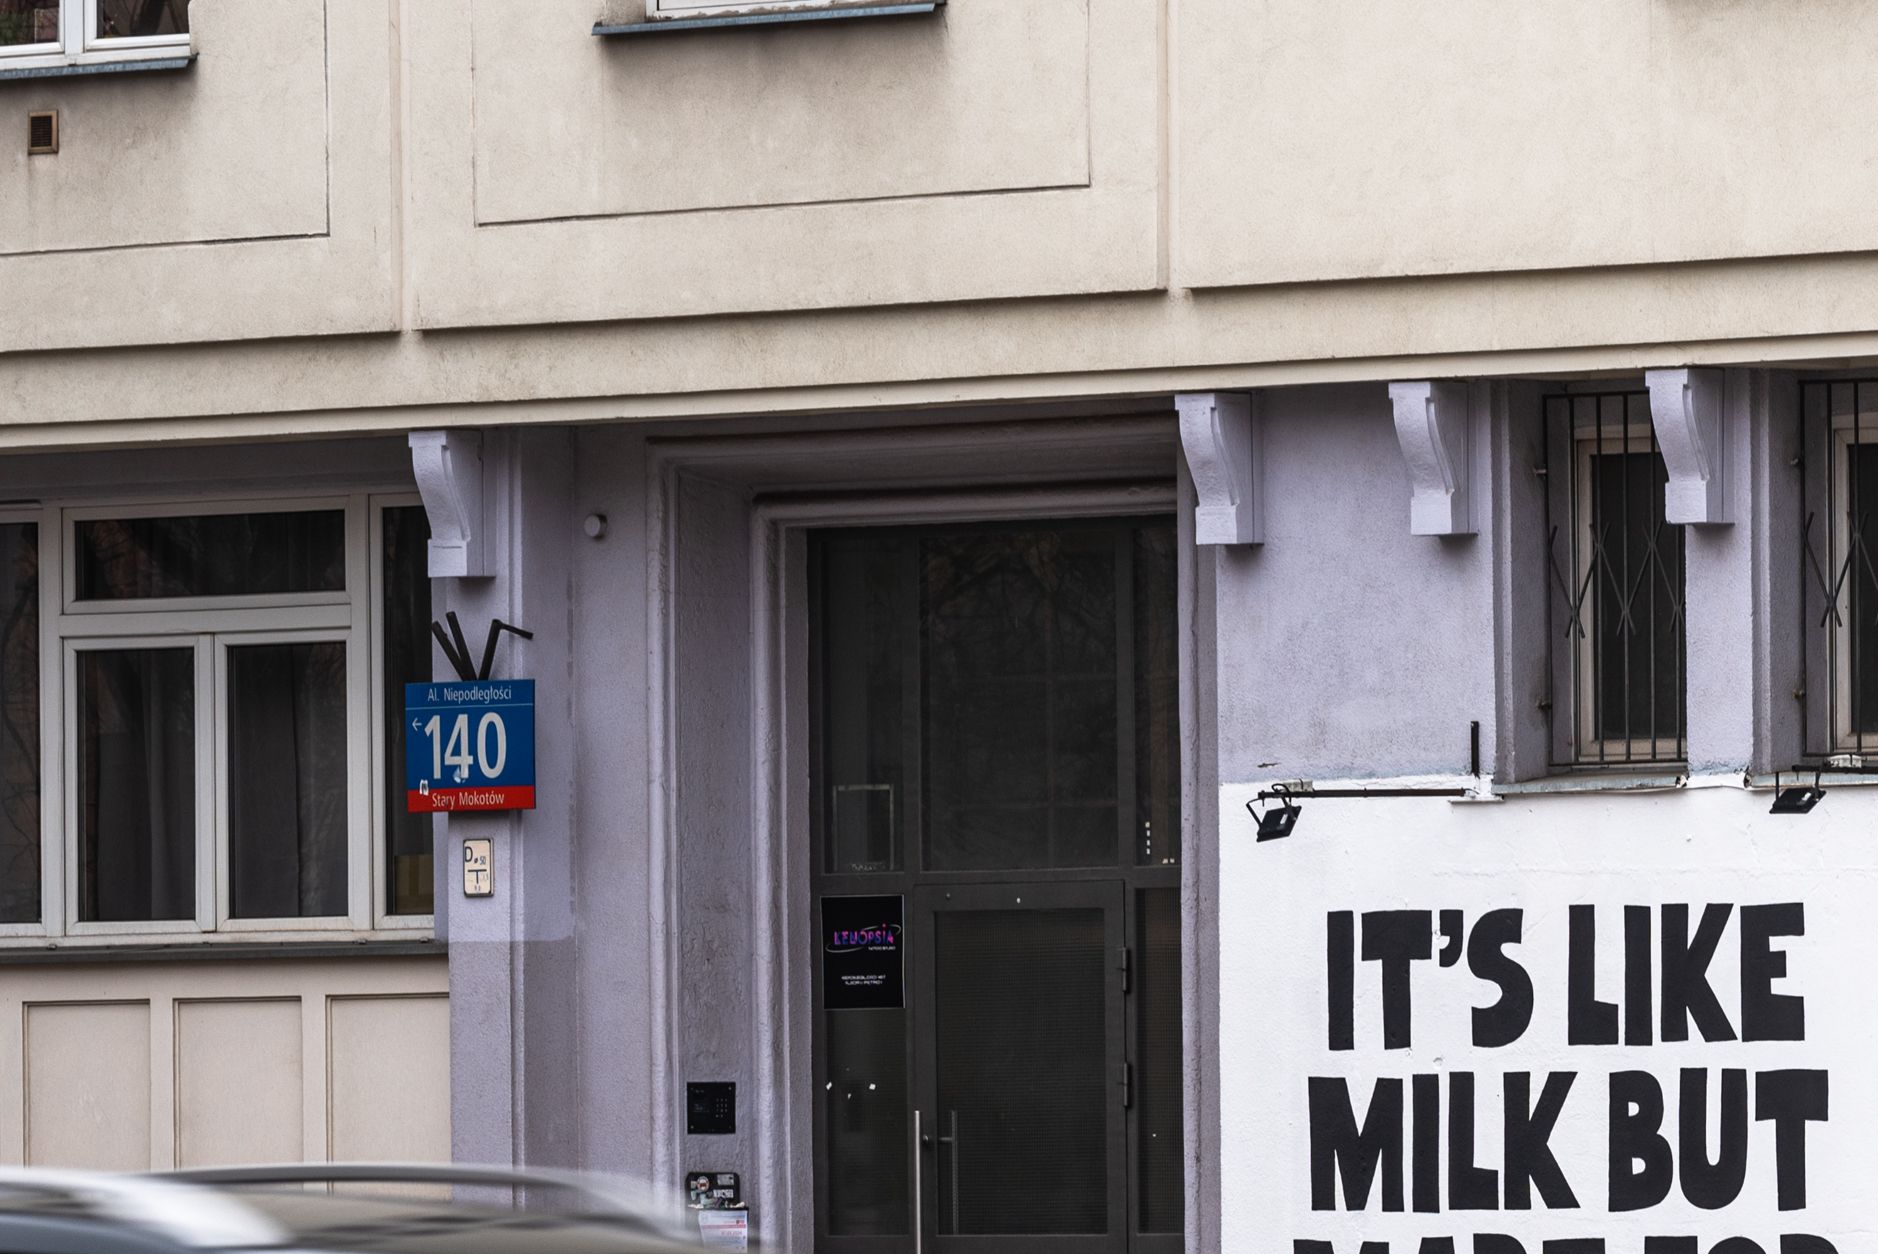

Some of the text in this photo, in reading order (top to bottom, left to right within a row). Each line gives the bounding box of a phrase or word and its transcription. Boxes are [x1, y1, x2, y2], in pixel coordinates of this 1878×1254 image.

[427, 685, 512, 704] Al. Niepodległości
[424, 711, 507, 780] 140
[431, 790, 505, 810] Stary Mokotów
[1326, 902, 1806, 1051] IT'S LIKE
[1307, 1067, 1829, 1214] MILK BUT
